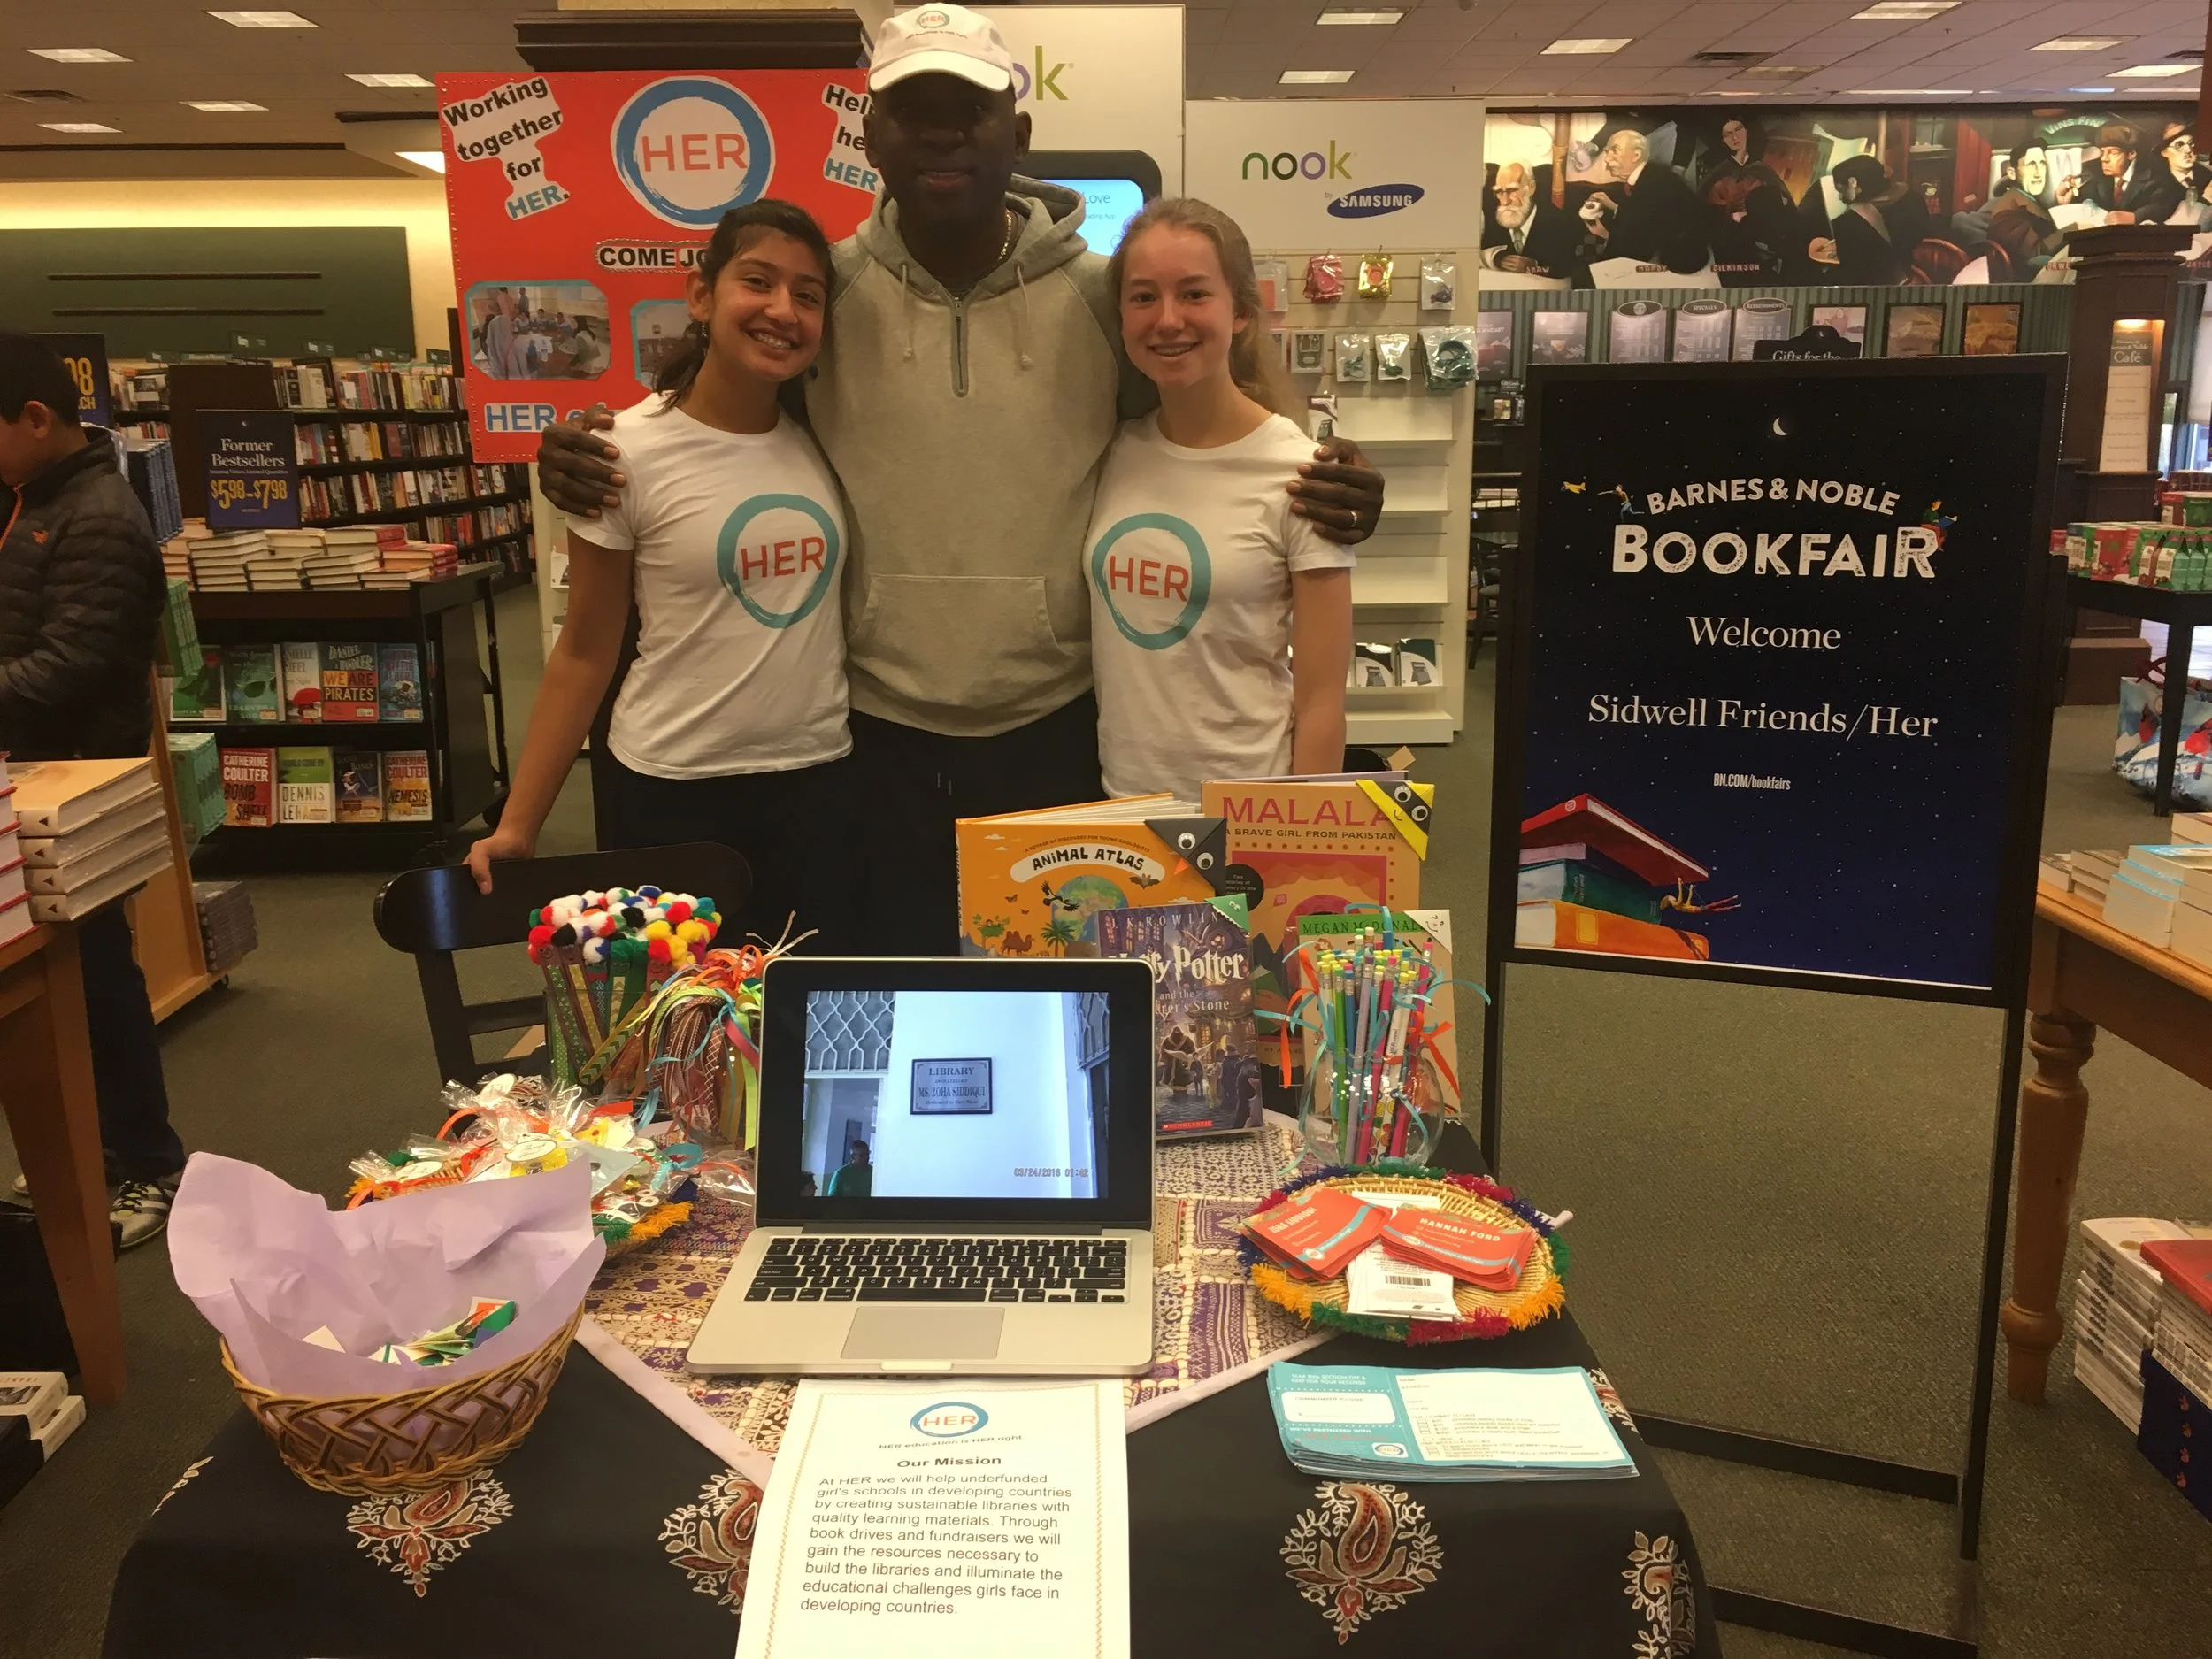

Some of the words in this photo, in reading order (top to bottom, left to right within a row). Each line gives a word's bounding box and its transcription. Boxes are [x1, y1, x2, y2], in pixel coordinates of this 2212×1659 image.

[1012, 45, 1070, 101] ok
[442, 77, 549, 127] Working
[457, 110, 562, 161] together
[640, 133, 749, 173] HER
[1241, 139, 1353, 180] nook
[506, 157, 541, 181] for
[824, 157, 879, 192] HER
[506, 184, 570, 219] HER.
[1339, 194, 1413, 208] SAMSUNG
[598, 245, 677, 268] COME
[1711, 264, 1761, 273] DICKINSON
[1771, 349, 1803, 362] Gifts
[1804, 350, 1818, 361] for
[2113, 350, 2142, 364] Café
[485, 403, 557, 432] HER
[220, 437, 273, 452] Former
[211, 453, 286, 467] Bestsellers
[1647, 478, 1765, 515] BARNES
[1769, 477, 1790, 500] &
[1795, 479, 1901, 517] NOBLE
[740, 535, 826, 581] HER
[1612, 523, 1939, 579] BOOKFAIR
[1109, 555, 1190, 603] HER
[1686, 615, 1842, 650] Welcome
[324, 672, 346, 686] WE
[348, 672, 374, 687] ARE
[325, 687, 375, 702] PIRATES
[1587, 694, 1709, 728] Sidwell
[223, 755, 269, 768] CATHERINE
[385, 756, 428, 766] CATHERINE
[223, 766, 269, 782] COULTER
[385, 765, 428, 779] COULTER
[1712, 772, 1792, 792] BN.COM/bookfairs
[224, 783, 257, 801] BOMB
[282, 786, 326, 803] DENNIS
[389, 789, 429, 803] NEMESIS
[1234, 828, 1272, 837] BRAVE
[1305, 830, 1338, 839] FROM
[1341, 831, 1397, 840] PAKISTAN
[1094, 848, 1144, 871] ATLAS
[1146, 913, 1218, 927] ROWLIN
[1302, 922, 1350, 934] MEGAN
[1173, 945, 1245, 988] Potter
[1159, 989, 1177, 1000] and
[1179, 988, 1194, 999] the
[1194, 998, 1230, 1011] Stone
[928, 1067, 975, 1076] LIBRARY
[932, 1086, 951, 1097] ZOHA
[952, 1086, 986, 1098] SIDDIQUI
[1169, 1119, 1212, 1129] SCHOLASTIC
[1419, 1217, 1468, 1235] HANNAH
[1470, 1230, 1501, 1242] FORD
[923, 1415, 977, 1427] HER
[934, 1455, 1002, 1466] Mission
[839, 1476, 872, 1485] HER
[901, 1474, 922, 1483] will
[926, 1474, 956, 1485] help
[960, 1474, 1048, 1484] underfunded
[817, 1487, 849, 1498] girl's
[911, 1486, 923, 1495] in
[928, 1486, 1004, 1498] developing
[1009, 1487, 1072, 1497] countries
[814, 1499, 832, 1510] by
[836, 1499, 892, 1511] creating
[897, 1500, 978, 1510] sustainable
[982, 1500, 1038, 1511] libraries
[1042, 1502, 1071, 1512] with
[811, 1512, 859, 1525] quality
[863, 1513, 920, 1527] learning
[925, 1514, 994, 1526] materials.
[999, 1515, 1058, 1531] Through
[810, 1527, 845, 1539] book
[849, 1528, 893, 1540] drives
[897, 1530, 925, 1541] and
[929, 1530, 1009, 1543] fundraisers
[1013, 1534, 1034, 1544] we
[1038, 1533, 1061, 1545] will
[807, 1544, 838, 1558] gain
[842, 1545, 866, 1557] the
[871, 1548, 942, 1559] resources
[947, 1549, 1021, 1564] necessary
[1025, 1550, 1039, 1563] to
[805, 1561, 840, 1574] build
[845, 1563, 868, 1575] the
[872, 1563, 930, 1577] libraries
[934, 1564, 962, 1578] and
[966, 1565, 1036, 1580] illuminate
[1040, 1568, 1063, 1580] the
[803, 1579, 888, 1594] educational
[892, 1581, 972, 1598] challenges
[976, 1584, 1007, 1600] girls
[1011, 1585, 1042, 1599] face
[1047, 1586, 1060, 1600] in
[800, 1598, 881, 1616] developing
[886, 1601, 958, 1615] countries.
